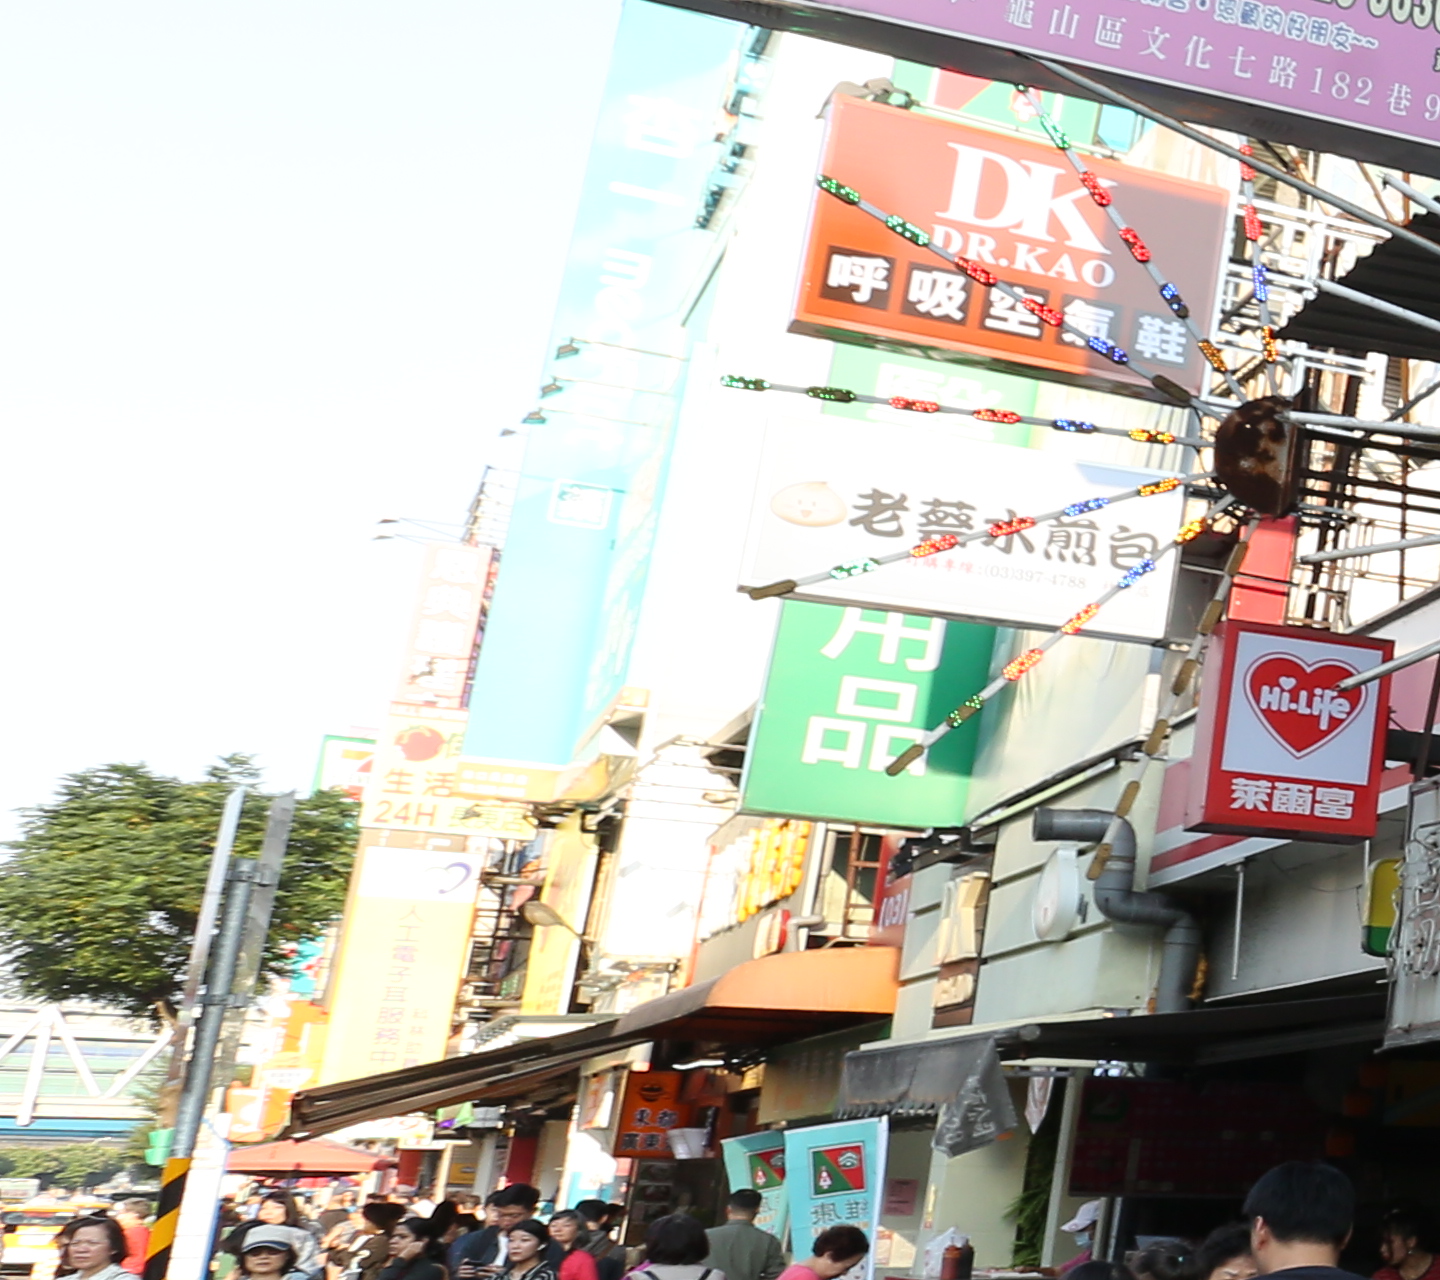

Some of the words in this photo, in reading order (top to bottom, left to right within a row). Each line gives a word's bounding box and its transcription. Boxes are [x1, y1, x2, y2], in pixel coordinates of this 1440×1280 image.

[935, 142, 1118, 255] DK
[931, 224, 1115, 288] DR.KAO
[827, 254, 1188, 364] 呼吸空氣鞋
[849, 488, 1158, 572] 老蔡水煎包
[800, 607, 947, 776] 用品
[1259, 676, 1350, 731] Hi-Life
[372, 800, 437, 826] 24H
[1230, 778, 1354, 819] 萊爾富
[367, 905, 424, 1076] 人工電子耳服務中
